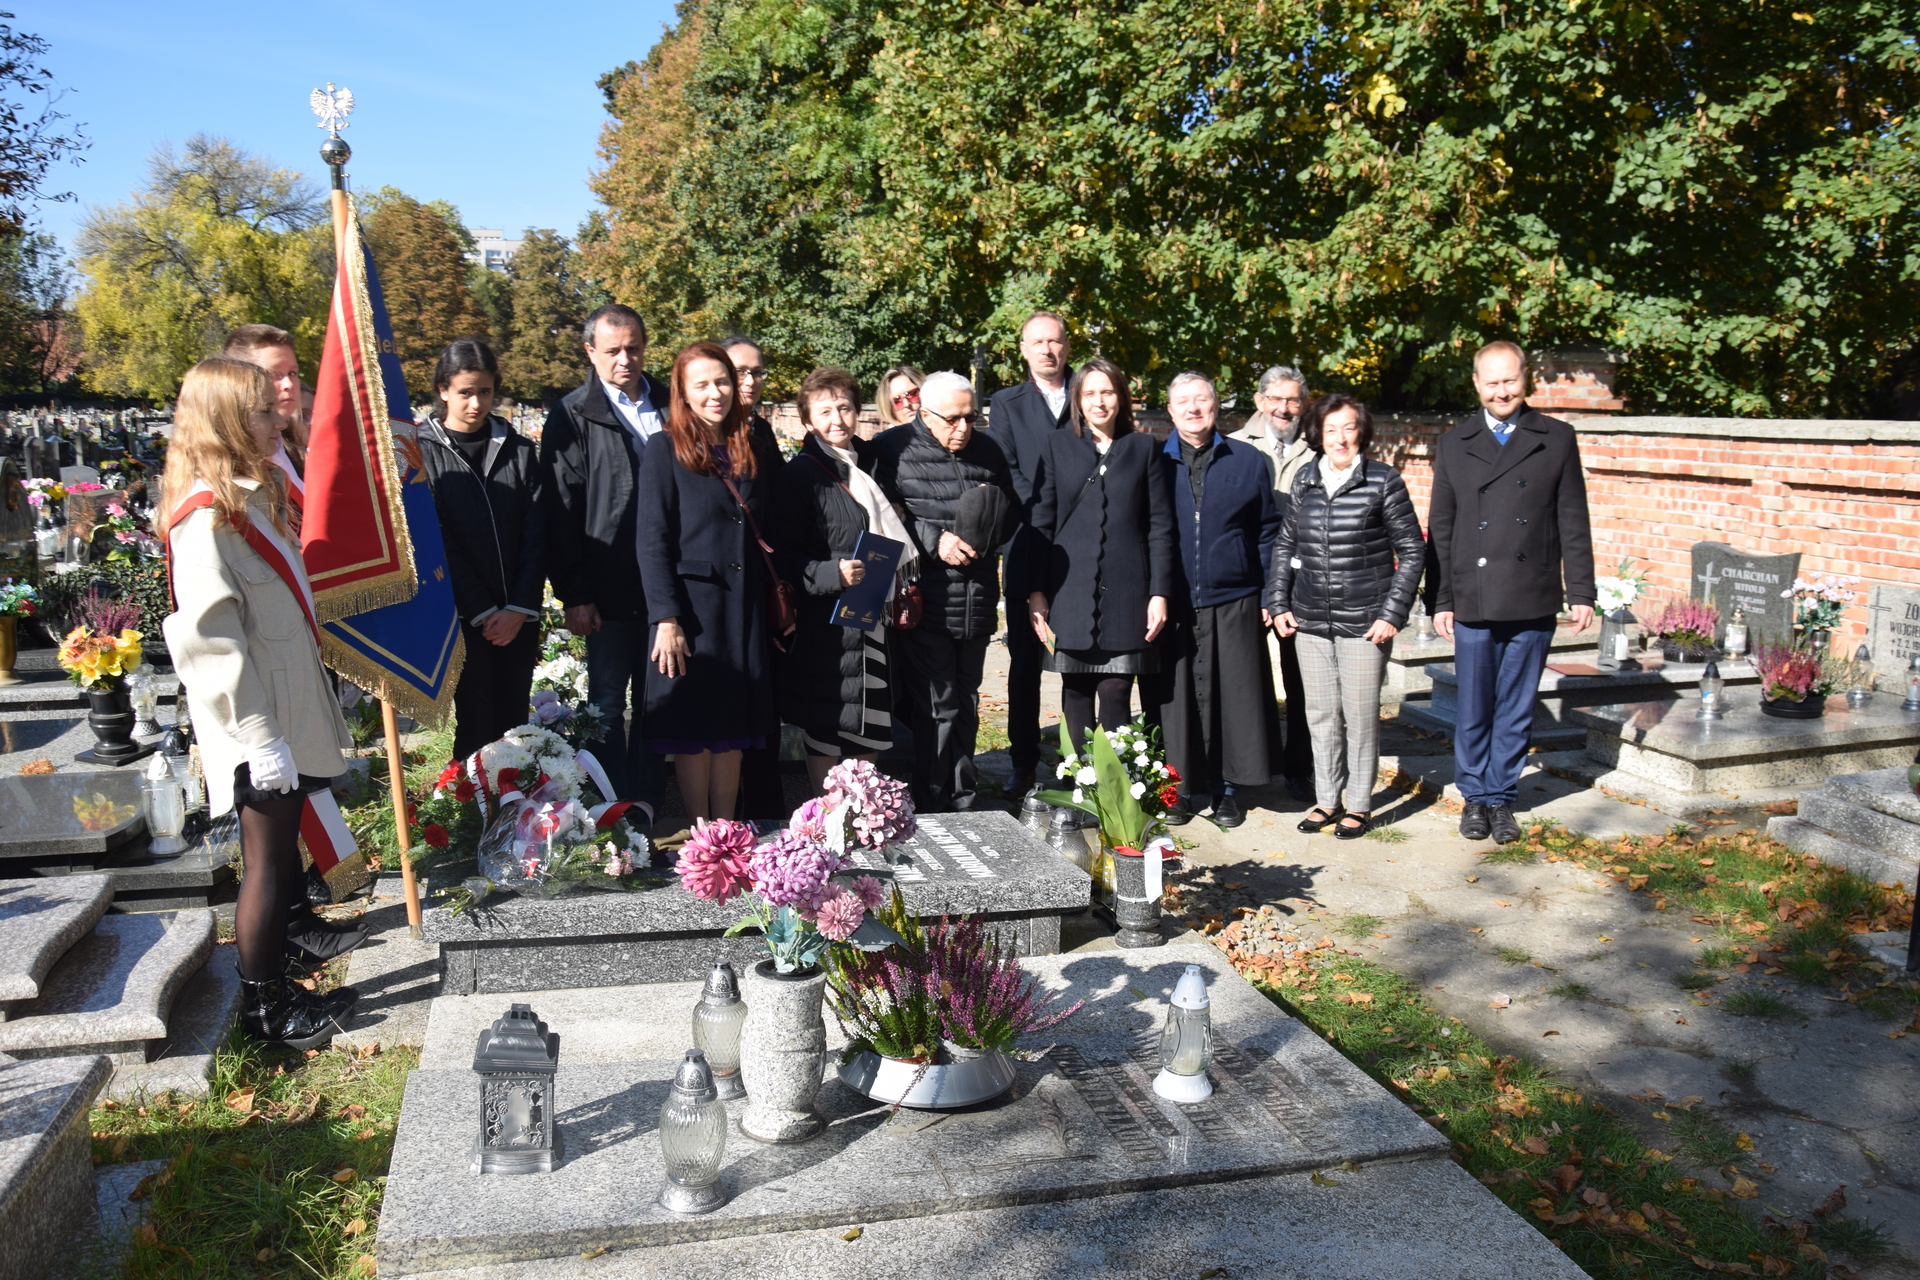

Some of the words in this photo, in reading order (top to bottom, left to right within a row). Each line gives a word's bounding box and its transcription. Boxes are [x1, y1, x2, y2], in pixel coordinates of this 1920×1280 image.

[1721, 567, 1779, 584] CHARCHAN
[1734, 582, 1766, 595] WITOLD
[940, 844, 997, 878] KAROLINA
